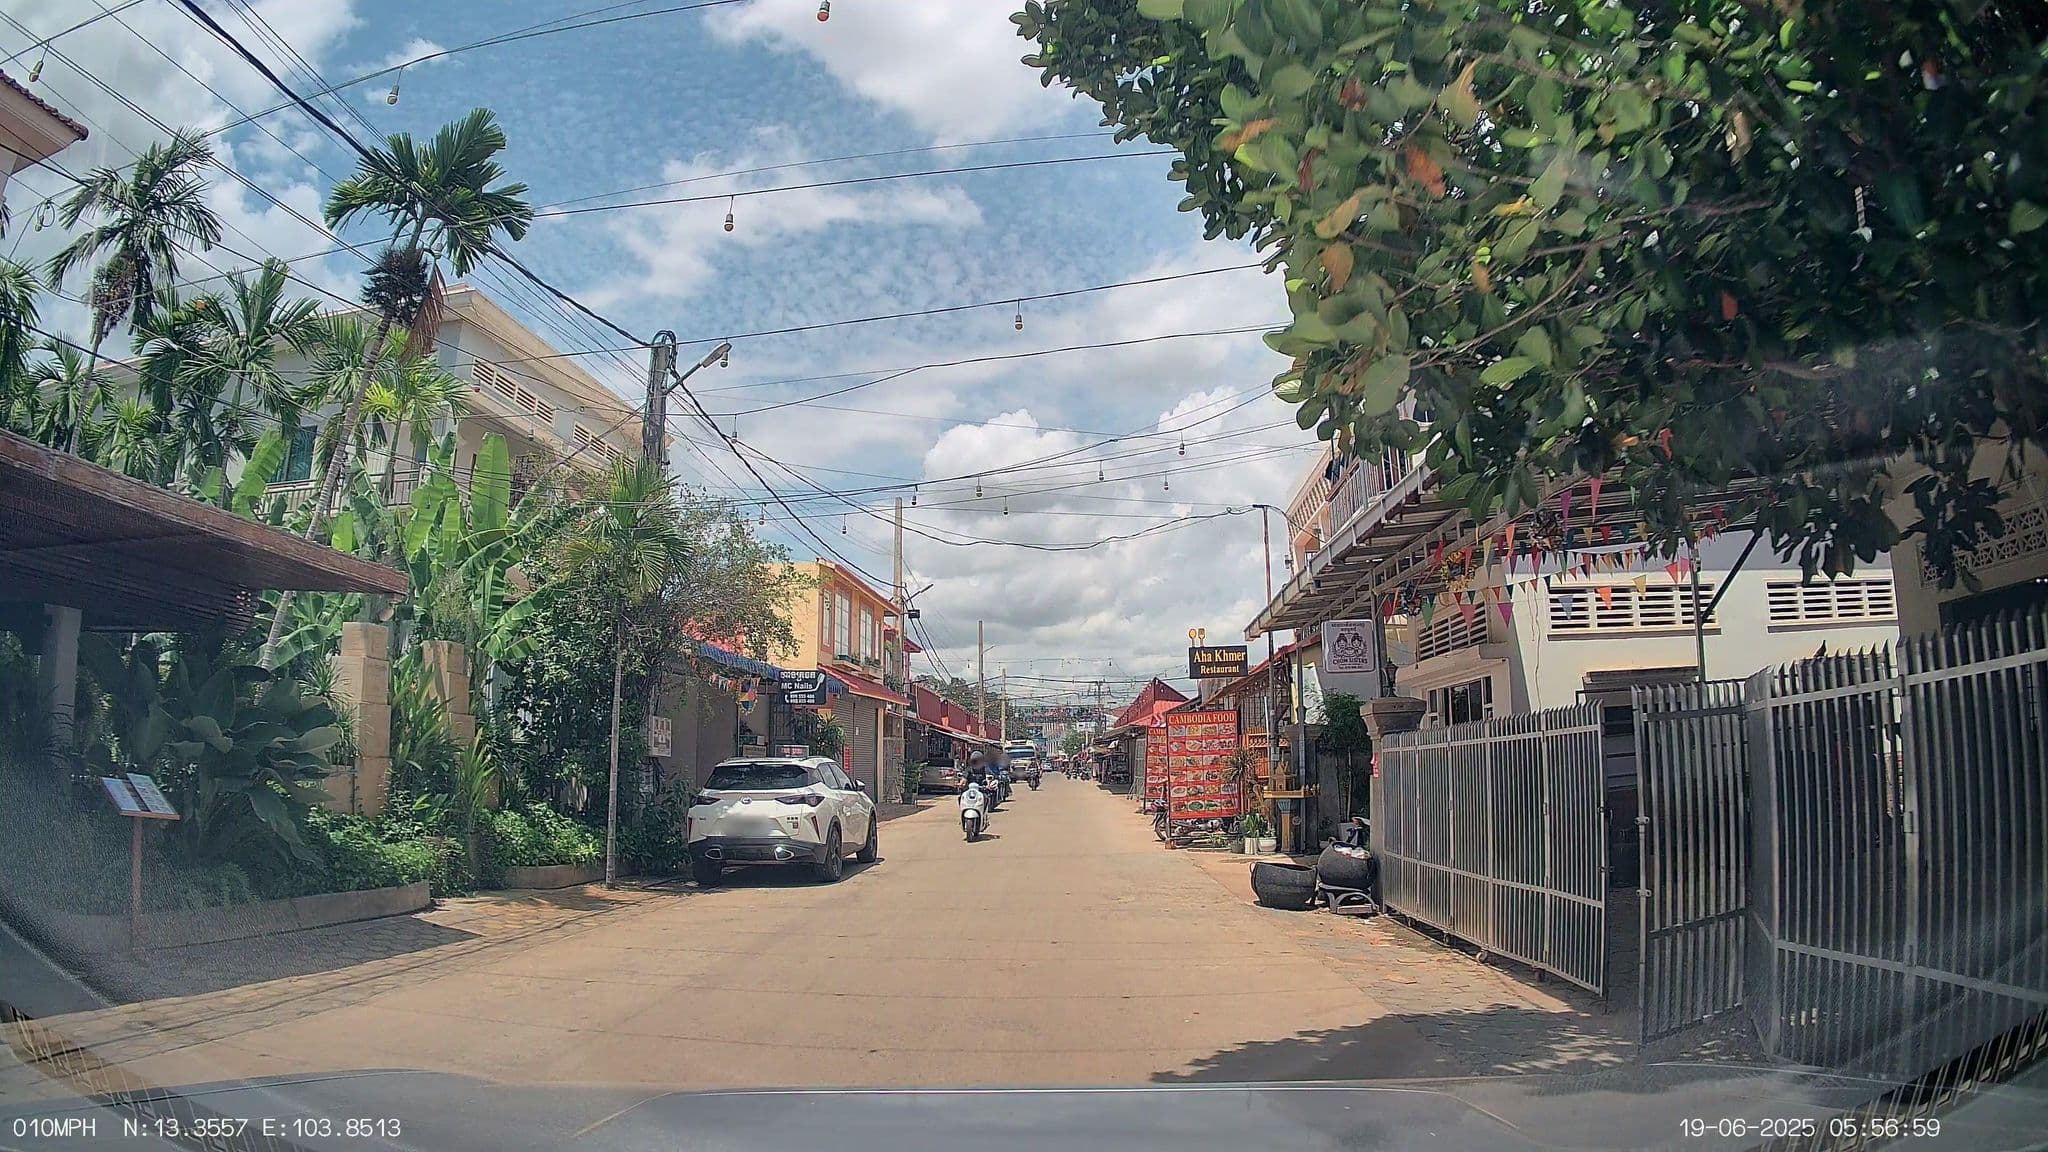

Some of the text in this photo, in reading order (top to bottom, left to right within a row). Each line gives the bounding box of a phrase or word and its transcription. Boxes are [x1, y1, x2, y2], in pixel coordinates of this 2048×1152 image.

[1215, 649, 1246, 662] Khmer
[1200, 665, 1239, 674] Restaurant
[780, 682, 813, 690] MC Nails
[1169, 712, 1235, 724] CAMBODIA FOOD
